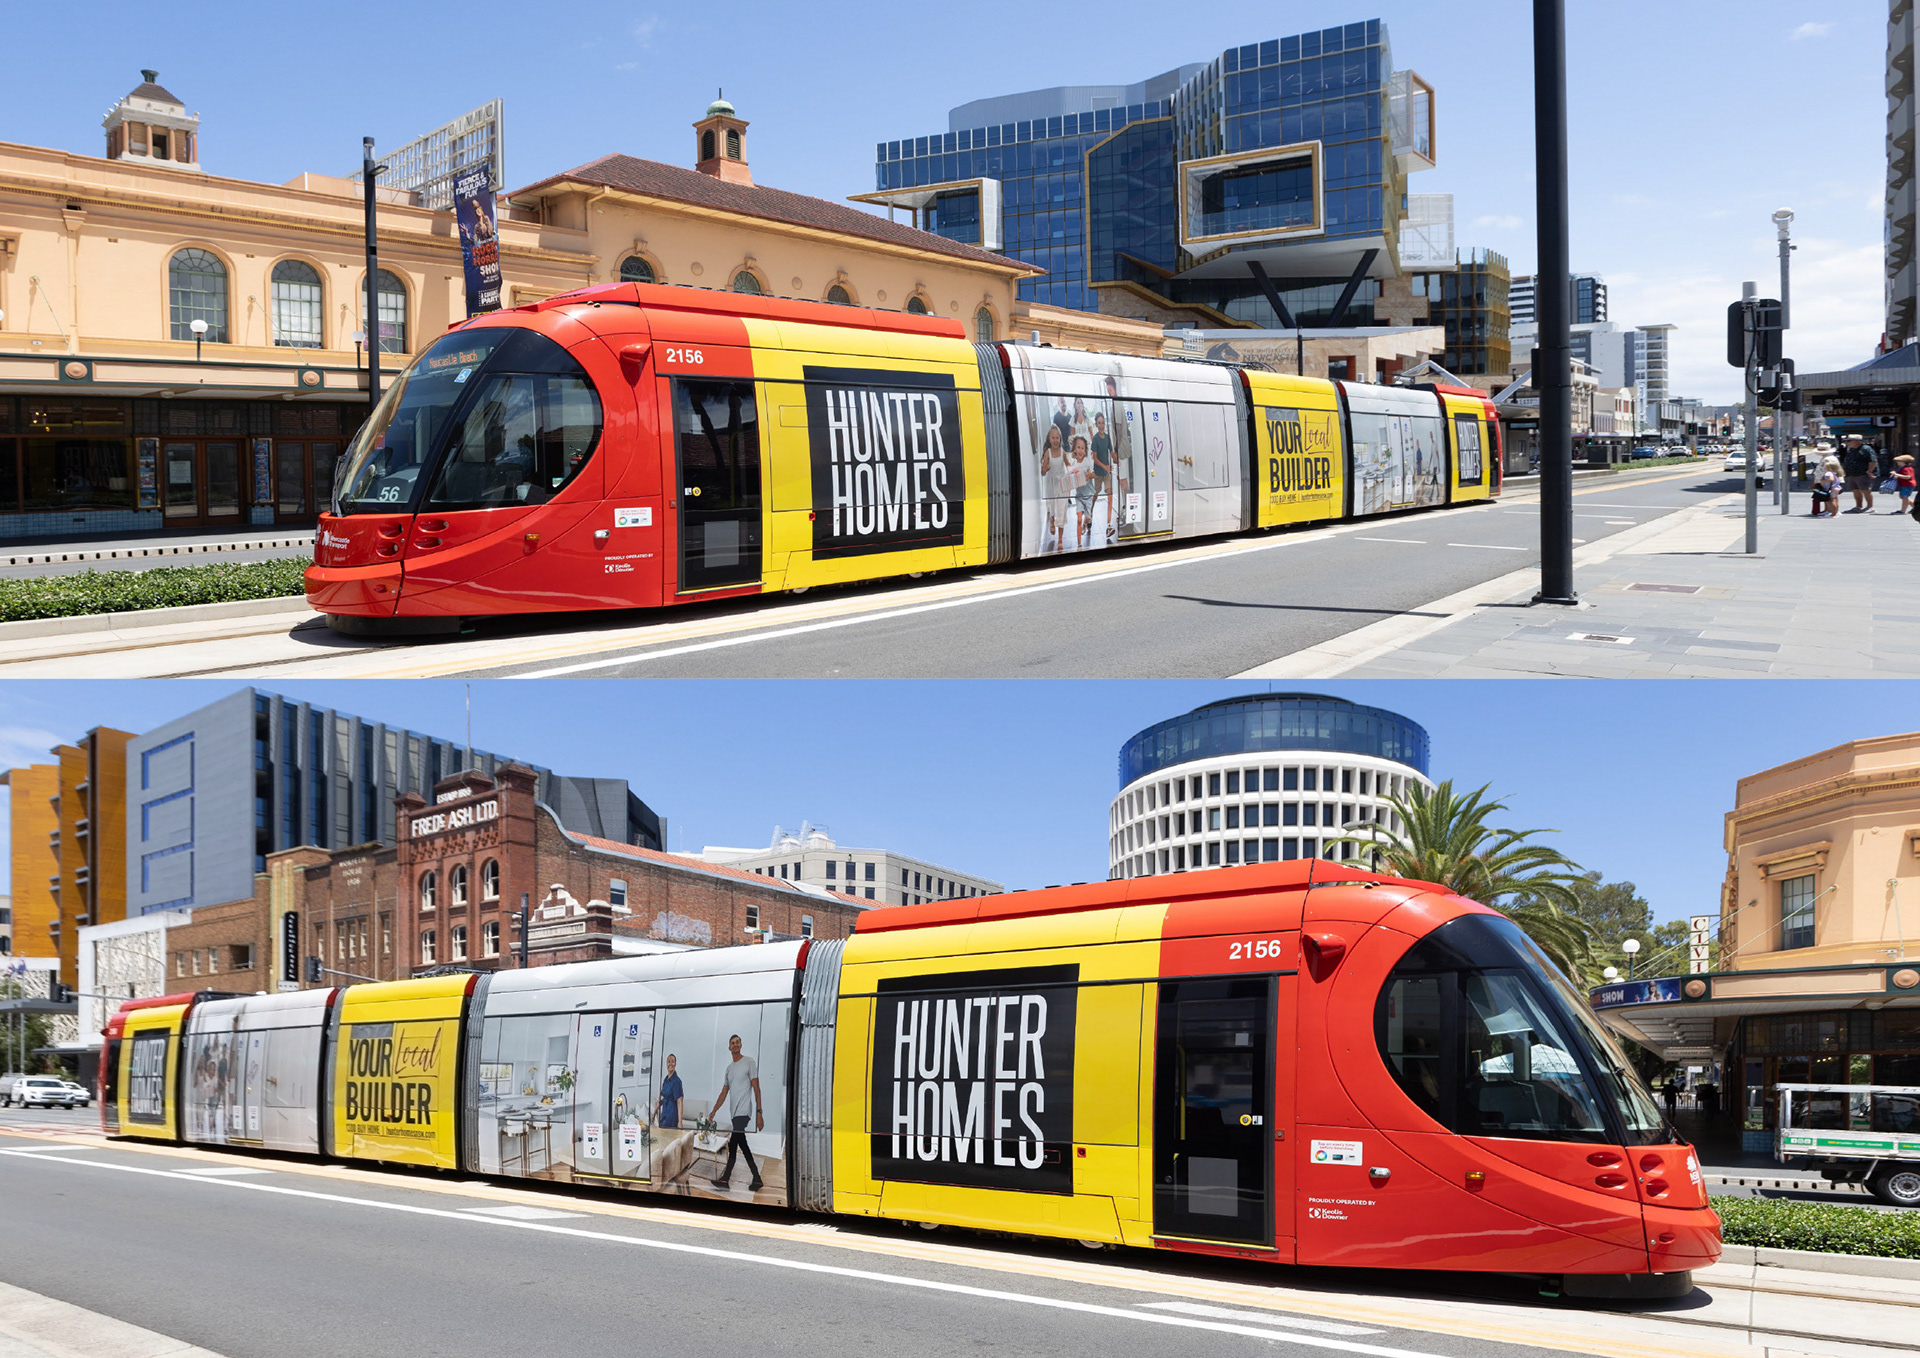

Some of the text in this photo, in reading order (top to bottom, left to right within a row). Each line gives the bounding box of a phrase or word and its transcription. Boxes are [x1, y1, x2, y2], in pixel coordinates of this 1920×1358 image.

[447, 103, 494, 137] CIVIC
[455, 177, 488, 196] FABULOUS
[464, 188, 478, 199] FUN
[459, 350, 478, 363] Beach
[665, 347, 704, 364] 2156
[825, 389, 946, 463] HUNTER
[1266, 414, 1330, 454] YOUR Local
[1457, 421, 1480, 450] HUNTER
[1269, 457, 1331, 493] BUILDER
[1460, 450, 1480, 479] HOMES
[379, 486, 400, 502] 56
[832, 460, 949, 537] HOMES
[476, 800, 499, 822] LTD.
[1229, 939, 1282, 960] 2156
[1601, 989, 1625, 1004] SHOW
[349, 1026, 442, 1078] YOUR Local
[893, 995, 1047, 1080] HUNTER
[132, 1038, 166, 1077] HUNTER
[131, 1076, 163, 1116] HOMES
[346, 1081, 432, 1126] BUILDER
[890, 1080, 1046, 1170] HOMES
[1321, 1213, 1349, 1221] Downer
